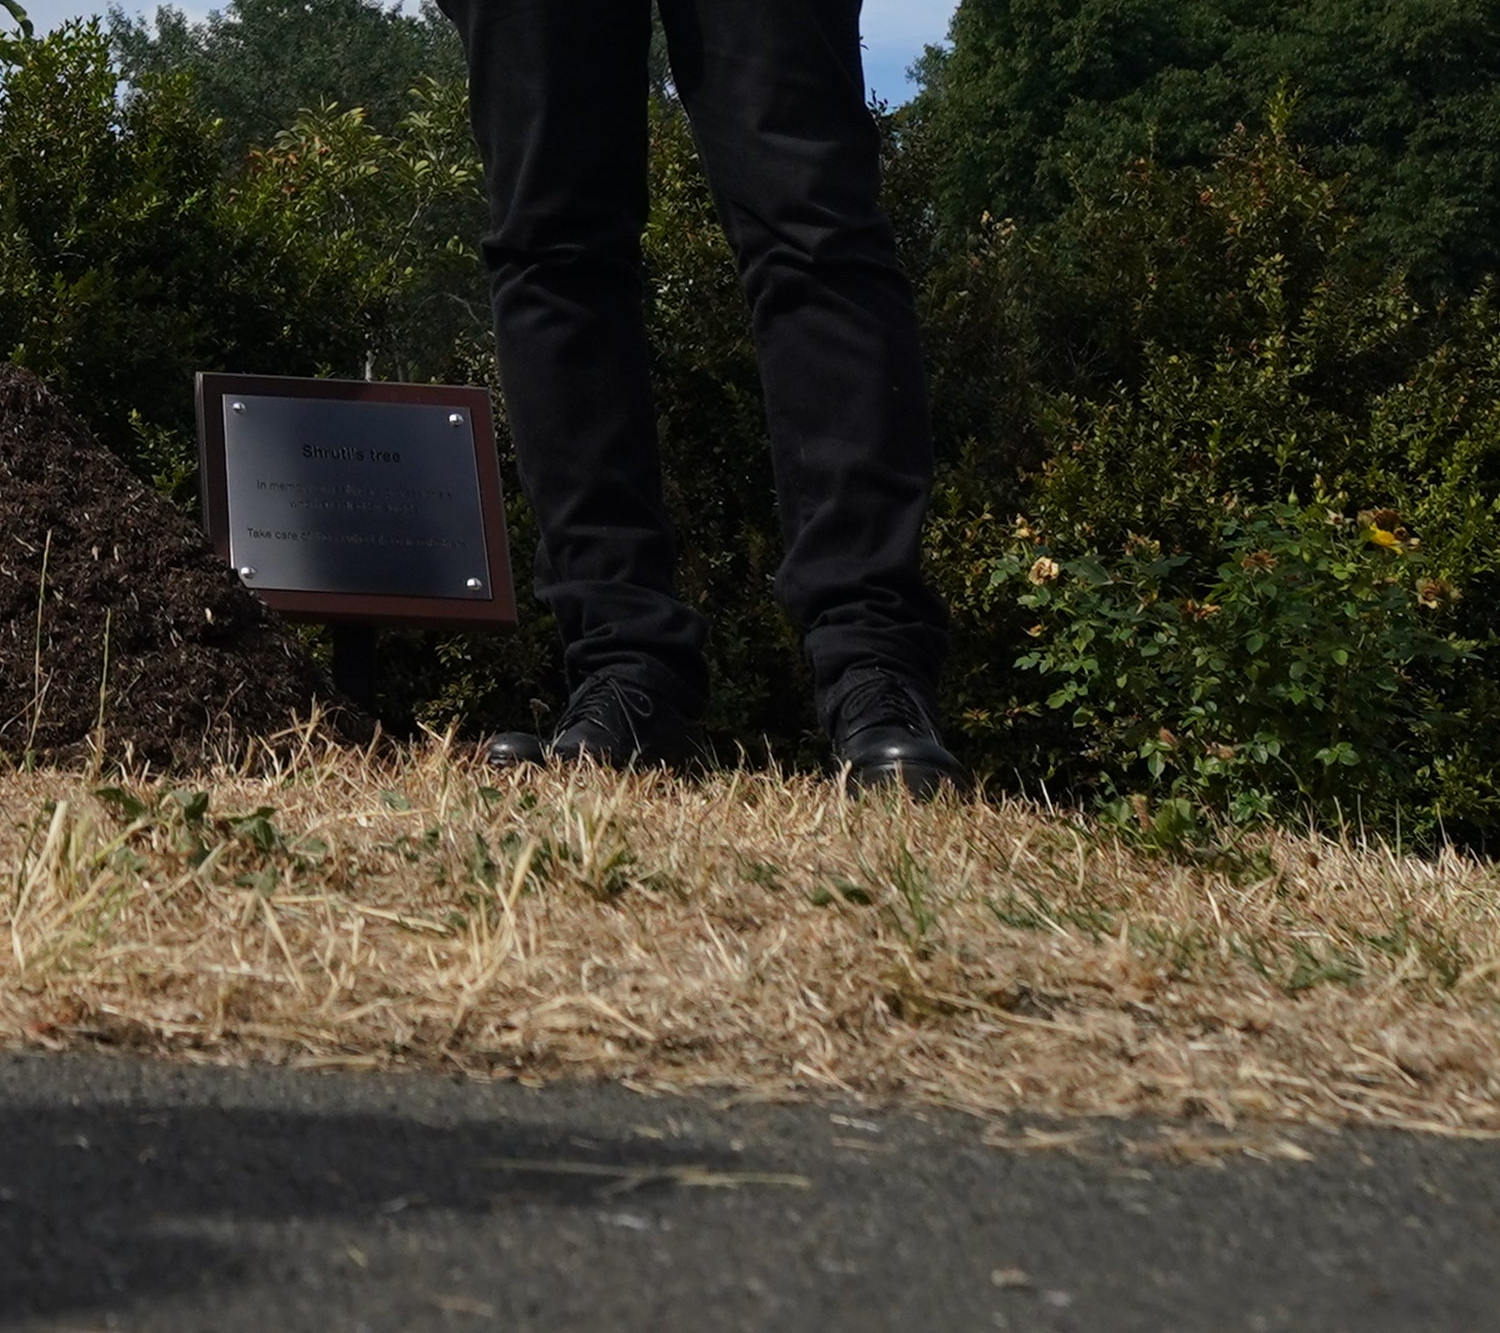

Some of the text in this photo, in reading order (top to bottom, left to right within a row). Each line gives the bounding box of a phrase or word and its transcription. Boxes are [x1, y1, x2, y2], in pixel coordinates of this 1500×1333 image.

[370, 447, 401, 464] tree
[256, 479, 267, 491] In
[247, 527, 272, 539] Take
[274, 530, 298, 541] care
